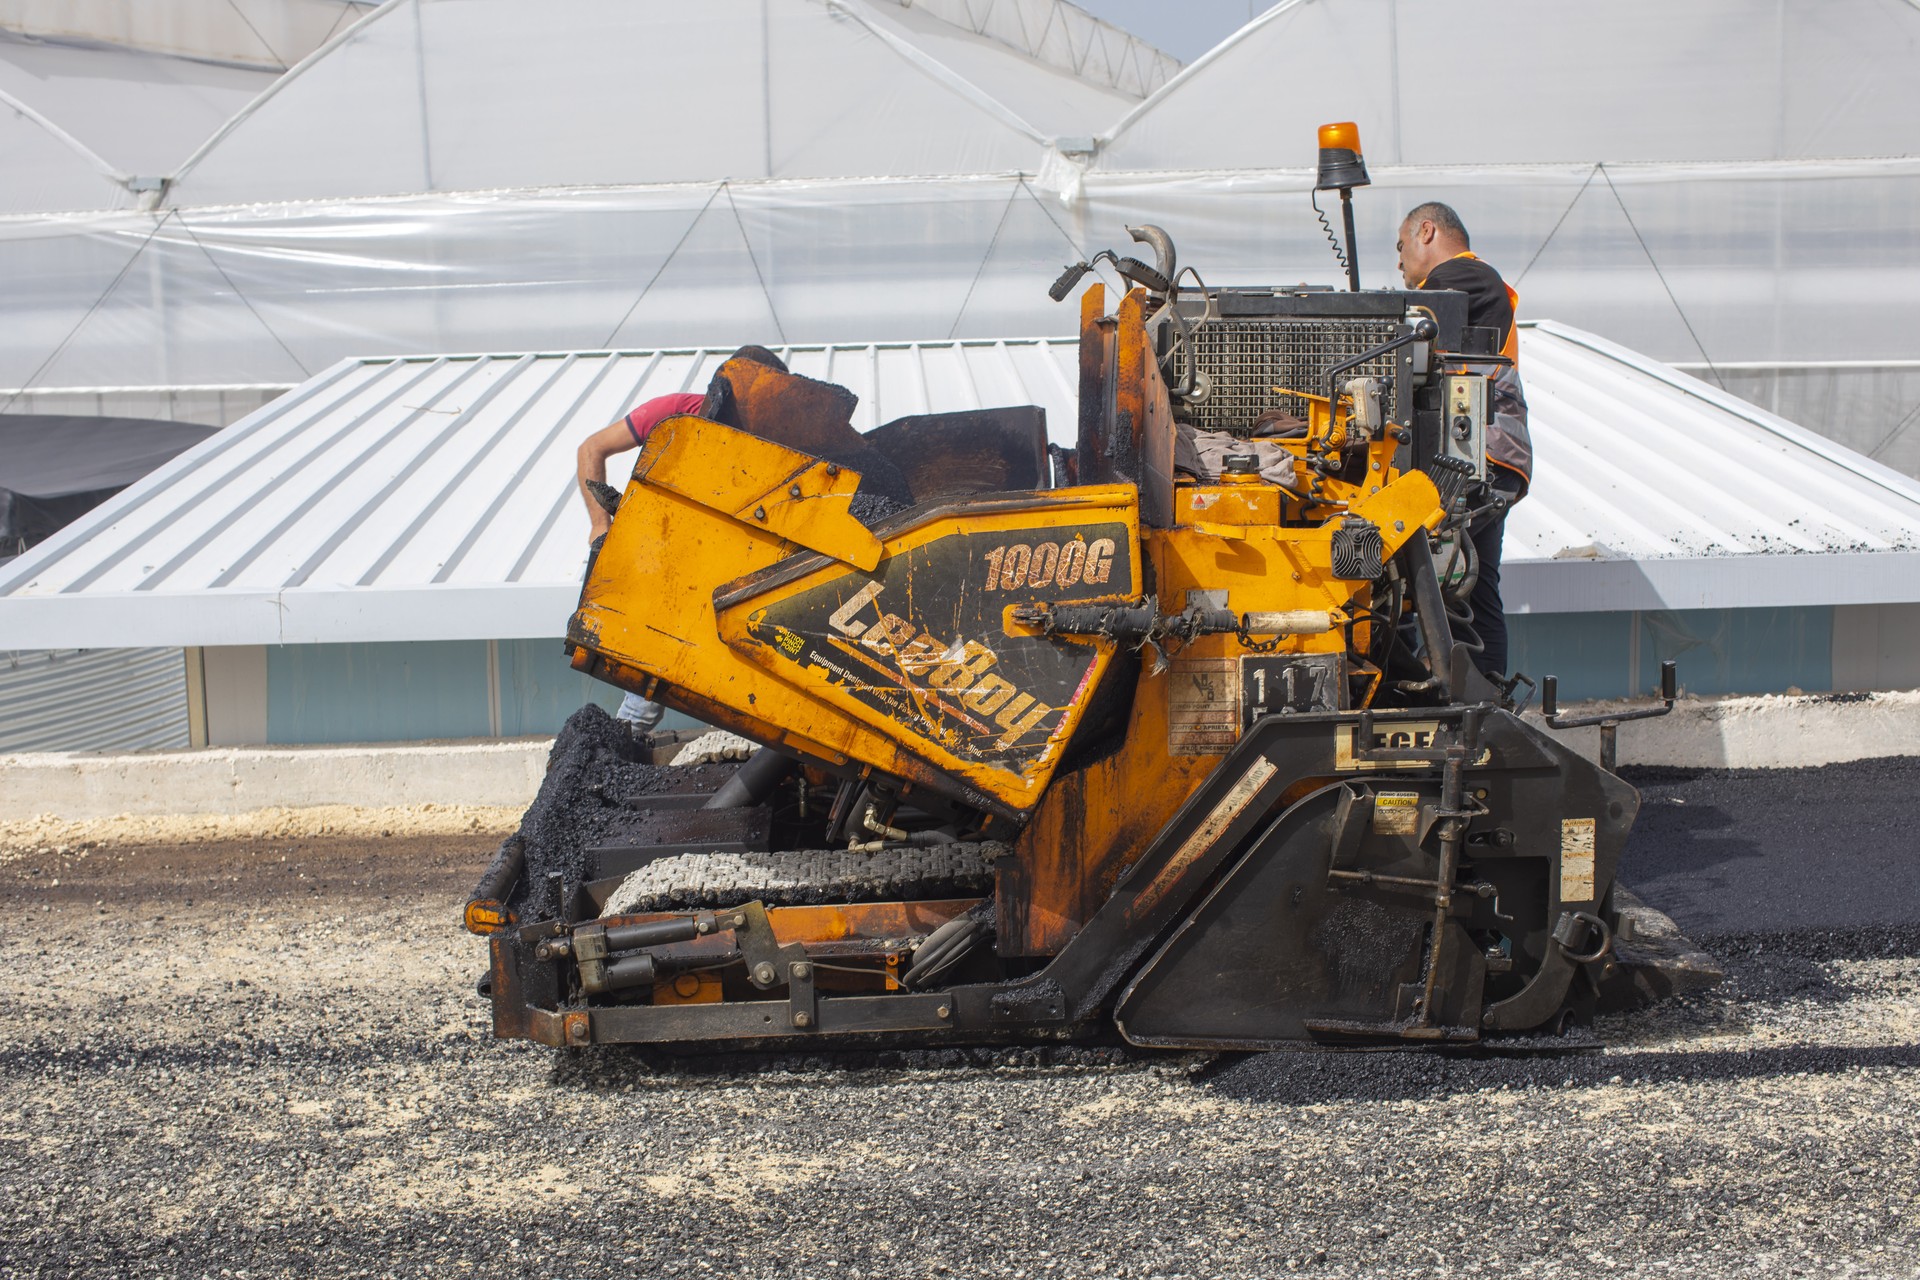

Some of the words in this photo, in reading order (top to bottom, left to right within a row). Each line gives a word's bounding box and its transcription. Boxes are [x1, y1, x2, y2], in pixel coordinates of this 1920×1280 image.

[984, 538, 1116, 591] 1000G
[781, 641, 800, 655] POINT
[783, 636, 803, 650] PINCH
[809, 650, 844, 675] Equipment
[1252, 667, 1326, 704] 117
